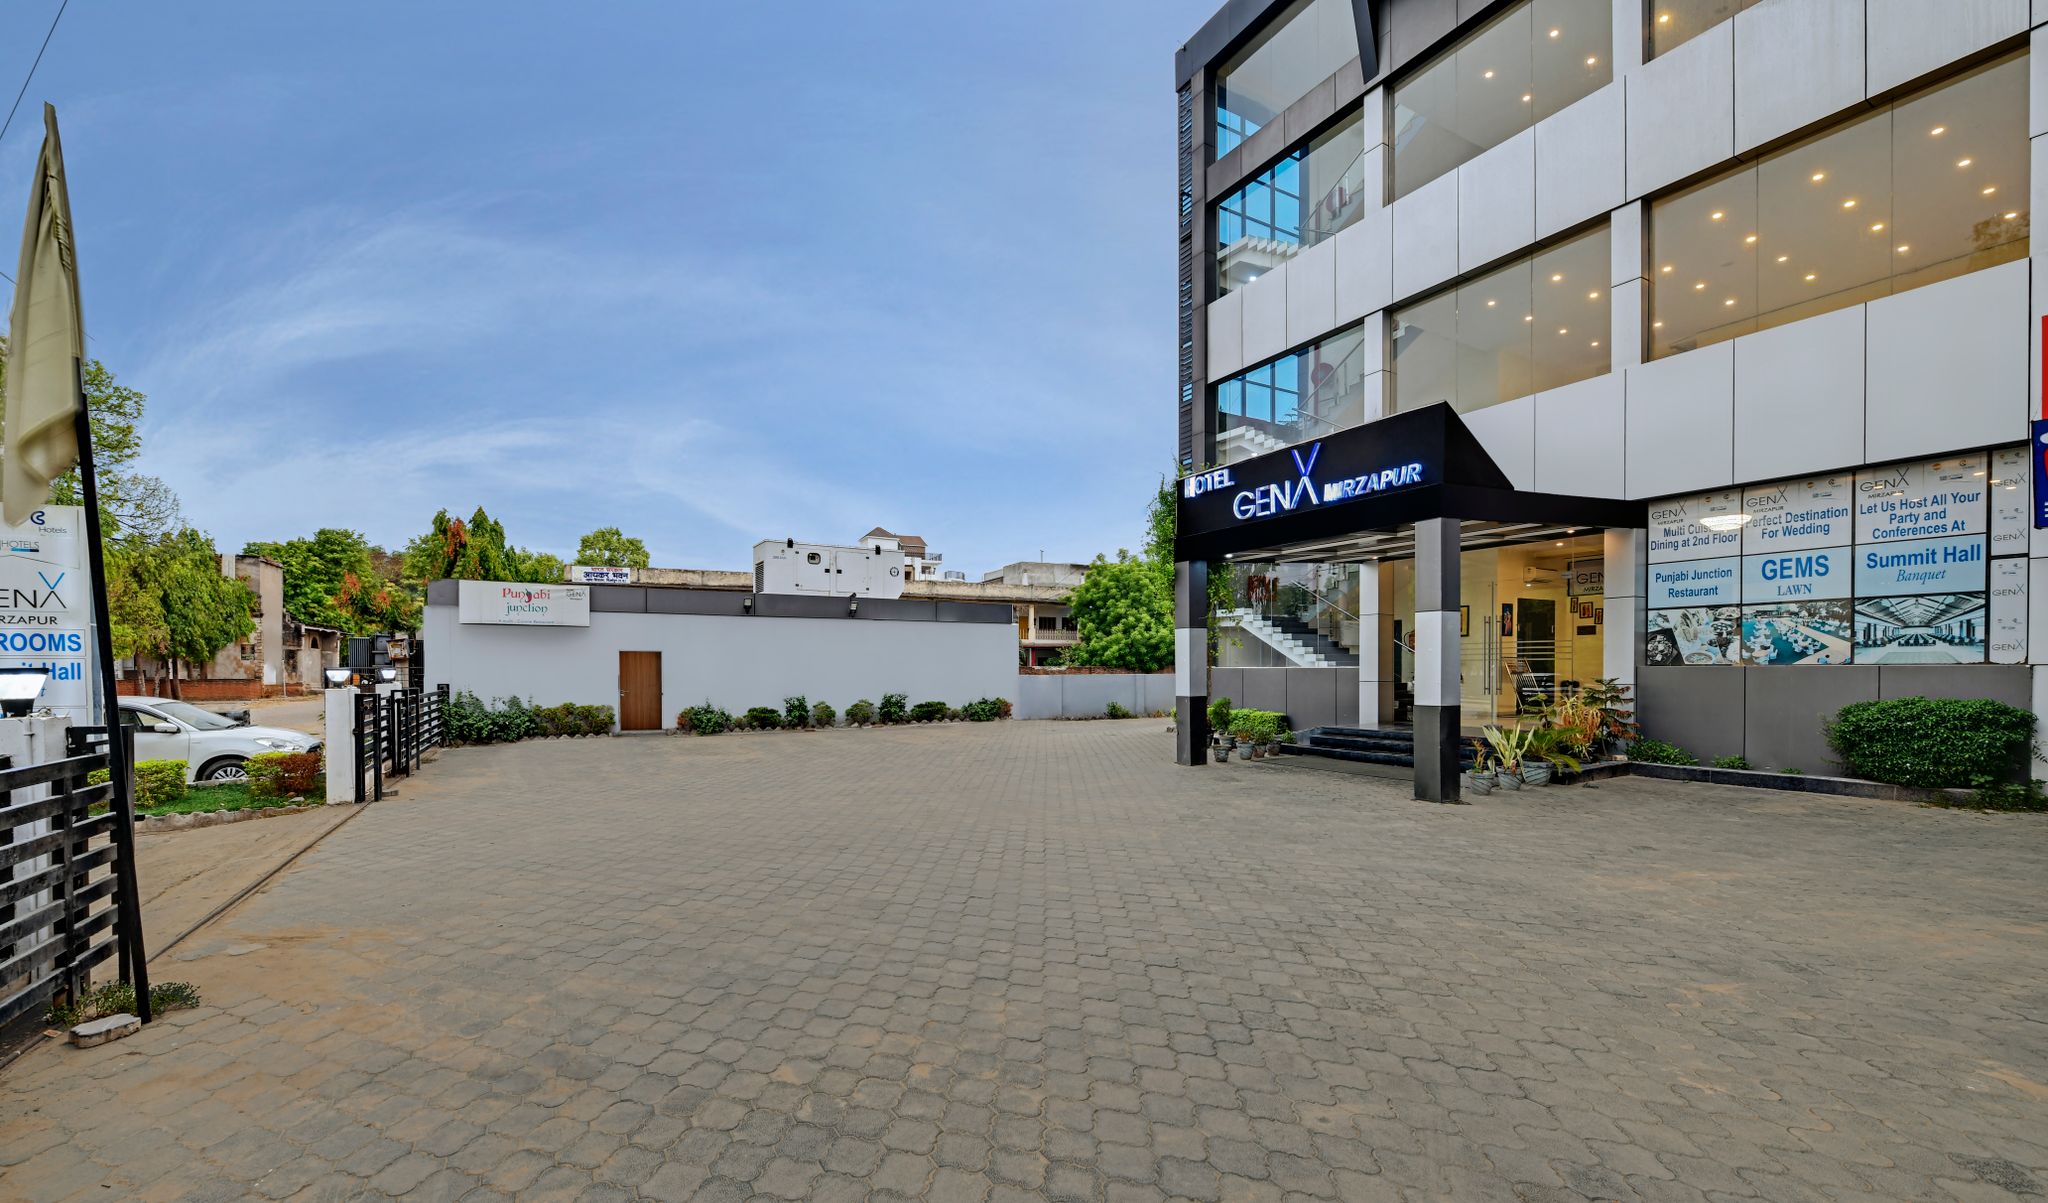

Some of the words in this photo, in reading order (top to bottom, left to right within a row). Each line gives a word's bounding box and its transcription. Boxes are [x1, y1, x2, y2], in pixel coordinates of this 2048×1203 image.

[1184, 468, 1236, 499] HOTEL
[1233, 442, 1322, 520] GENX
[1323, 463, 1423, 502] MIRZAPUR
[1860, 467, 1910, 491] GENX
[1746, 485, 1788, 507] GENX
[1860, 503, 1877, 515] Let
[1881, 501, 1896, 512] Us
[1900, 497, 1928, 510] Host
[1931, 493, 1947, 507] All
[1951, 491, 1981, 504] Your
[1651, 498, 1687, 520] GENX
[1785, 507, 1848, 523] Destination
[1889, 512, 1920, 525] Party
[1923, 507, 1947, 521] and
[1663, 524, 1686, 537] Multi
[1761, 528, 1779, 539] For
[1782, 523, 1830, 535] Wedding
[1872, 523, 1948, 540] Conferences
[1951, 519, 1966, 532] At
[1993, 528, 2026, 541] GENX
[2, 540, 40, 549] HOTELS
[1651, 539, 1679, 551] Dining
[1681, 537, 1690, 548] at
[1692, 535, 1709, 546] 2nd
[1713, 533, 1739, 544] Floor
[1866, 548, 1937, 569] Summit
[1944, 543, 1981, 563] Hall
[1655, 570, 1689, 584] Punjabi
[1691, 567, 1733, 580] Junction
[1761, 554, 1830, 581] GEMS
[1896, 569, 1947, 585] Banquet
[502, 587, 550, 603] Punjabi
[1668, 585, 1719, 598] Restaurant
[1777, 583, 1812, 597] LAWN
[1992, 583, 2025, 597] GENX
[505, 602, 548, 616] junction
[0, 633, 82, 652] ROOMS
[1991, 639, 2025, 651] GENX
